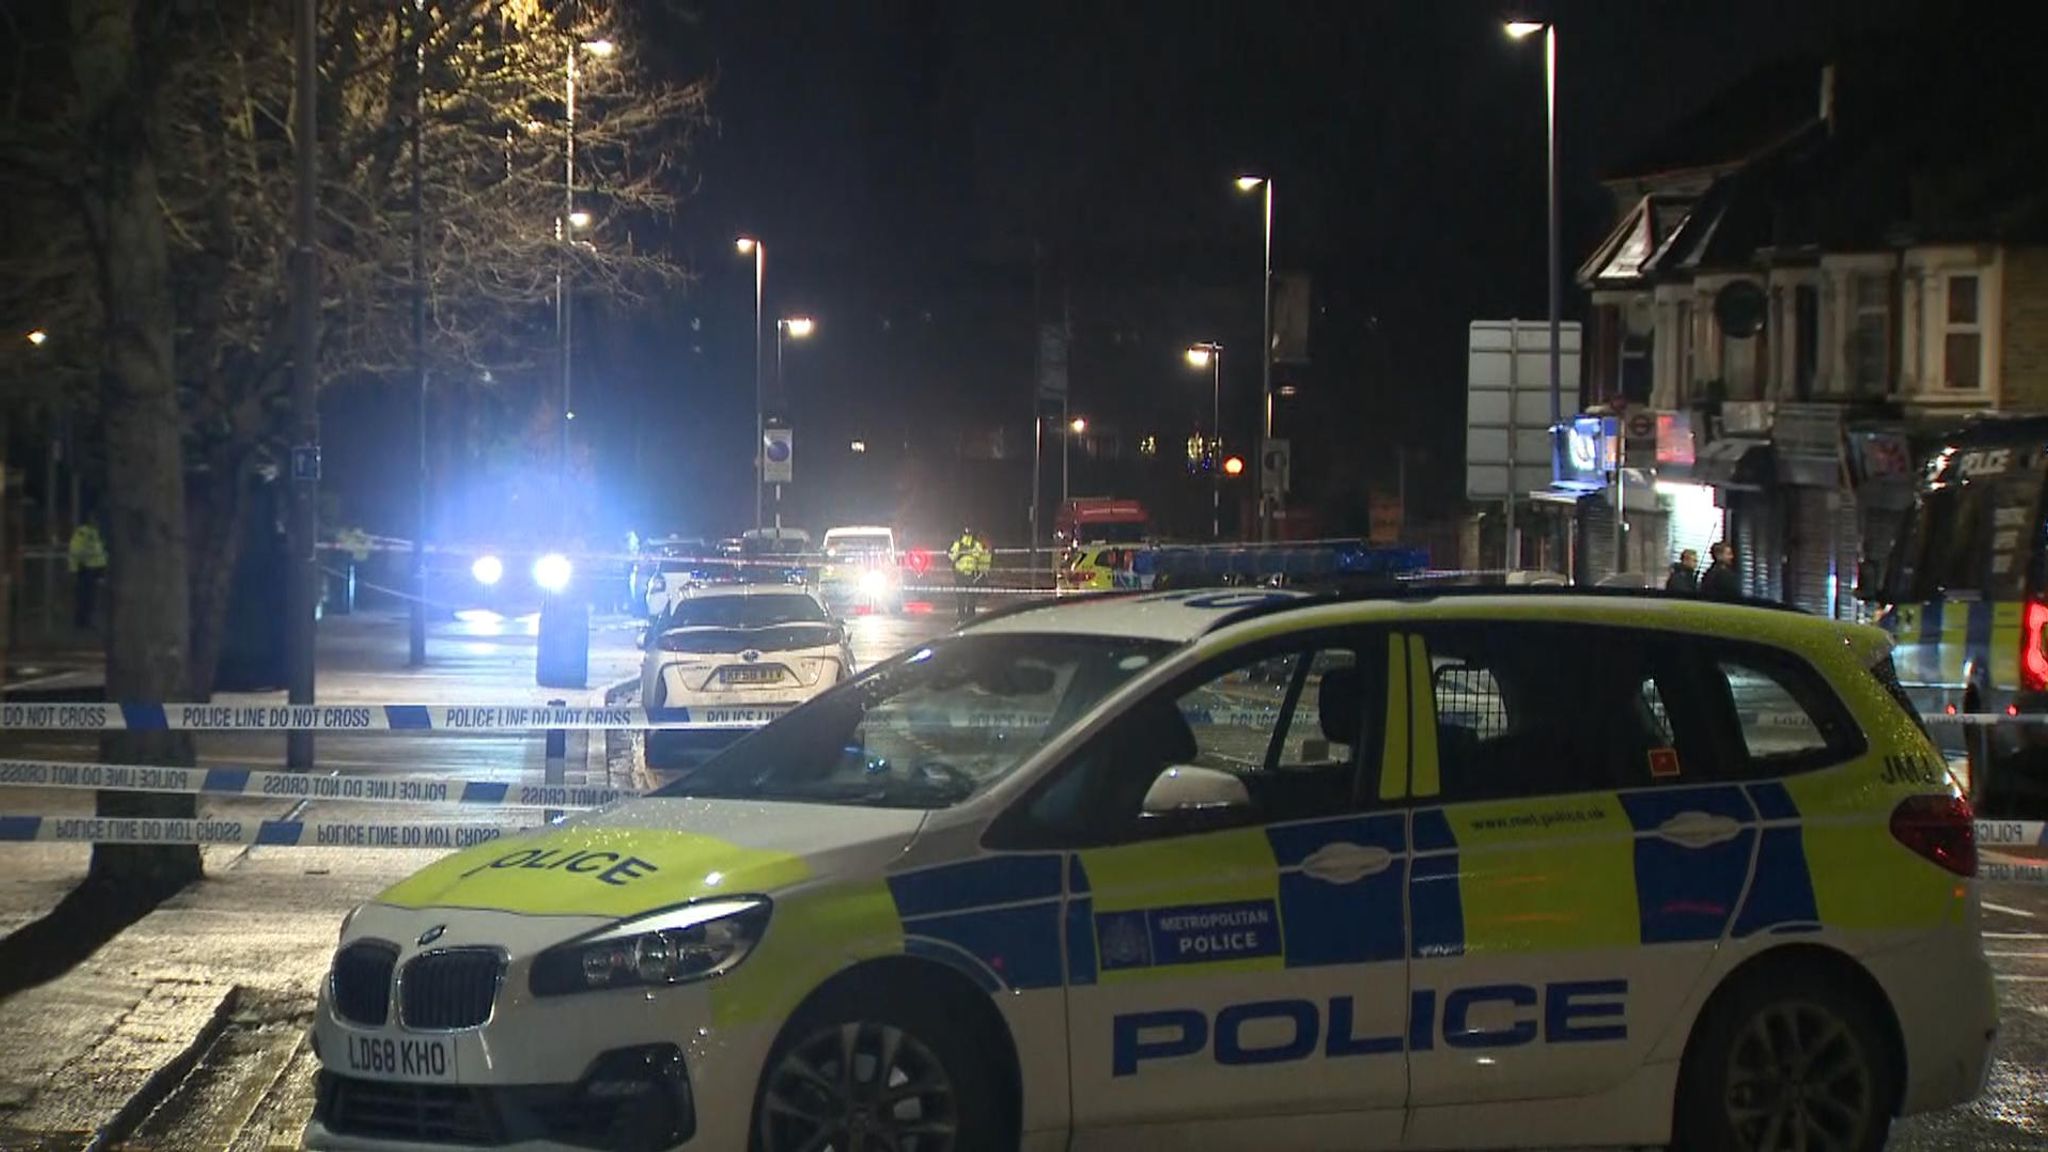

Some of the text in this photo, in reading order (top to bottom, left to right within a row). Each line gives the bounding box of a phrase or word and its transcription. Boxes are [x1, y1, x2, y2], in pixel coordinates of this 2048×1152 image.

[1957, 448, 2011, 477] POLICE
[2, 705, 107, 727] DO NOT CROSS
[182, 706, 370, 728] POLICE LINE DO NOT CROSS
[445, 707, 631, 728] POLICE LINE DO NOT CROSS
[706, 709, 755, 723] POLICE
[1160, 909, 1269, 931] METROPOLITAN
[1179, 931, 1258, 954] POLICE
[1112, 978, 1628, 1078] POLICE
[348, 1035, 446, 1076] LD68 KHO
